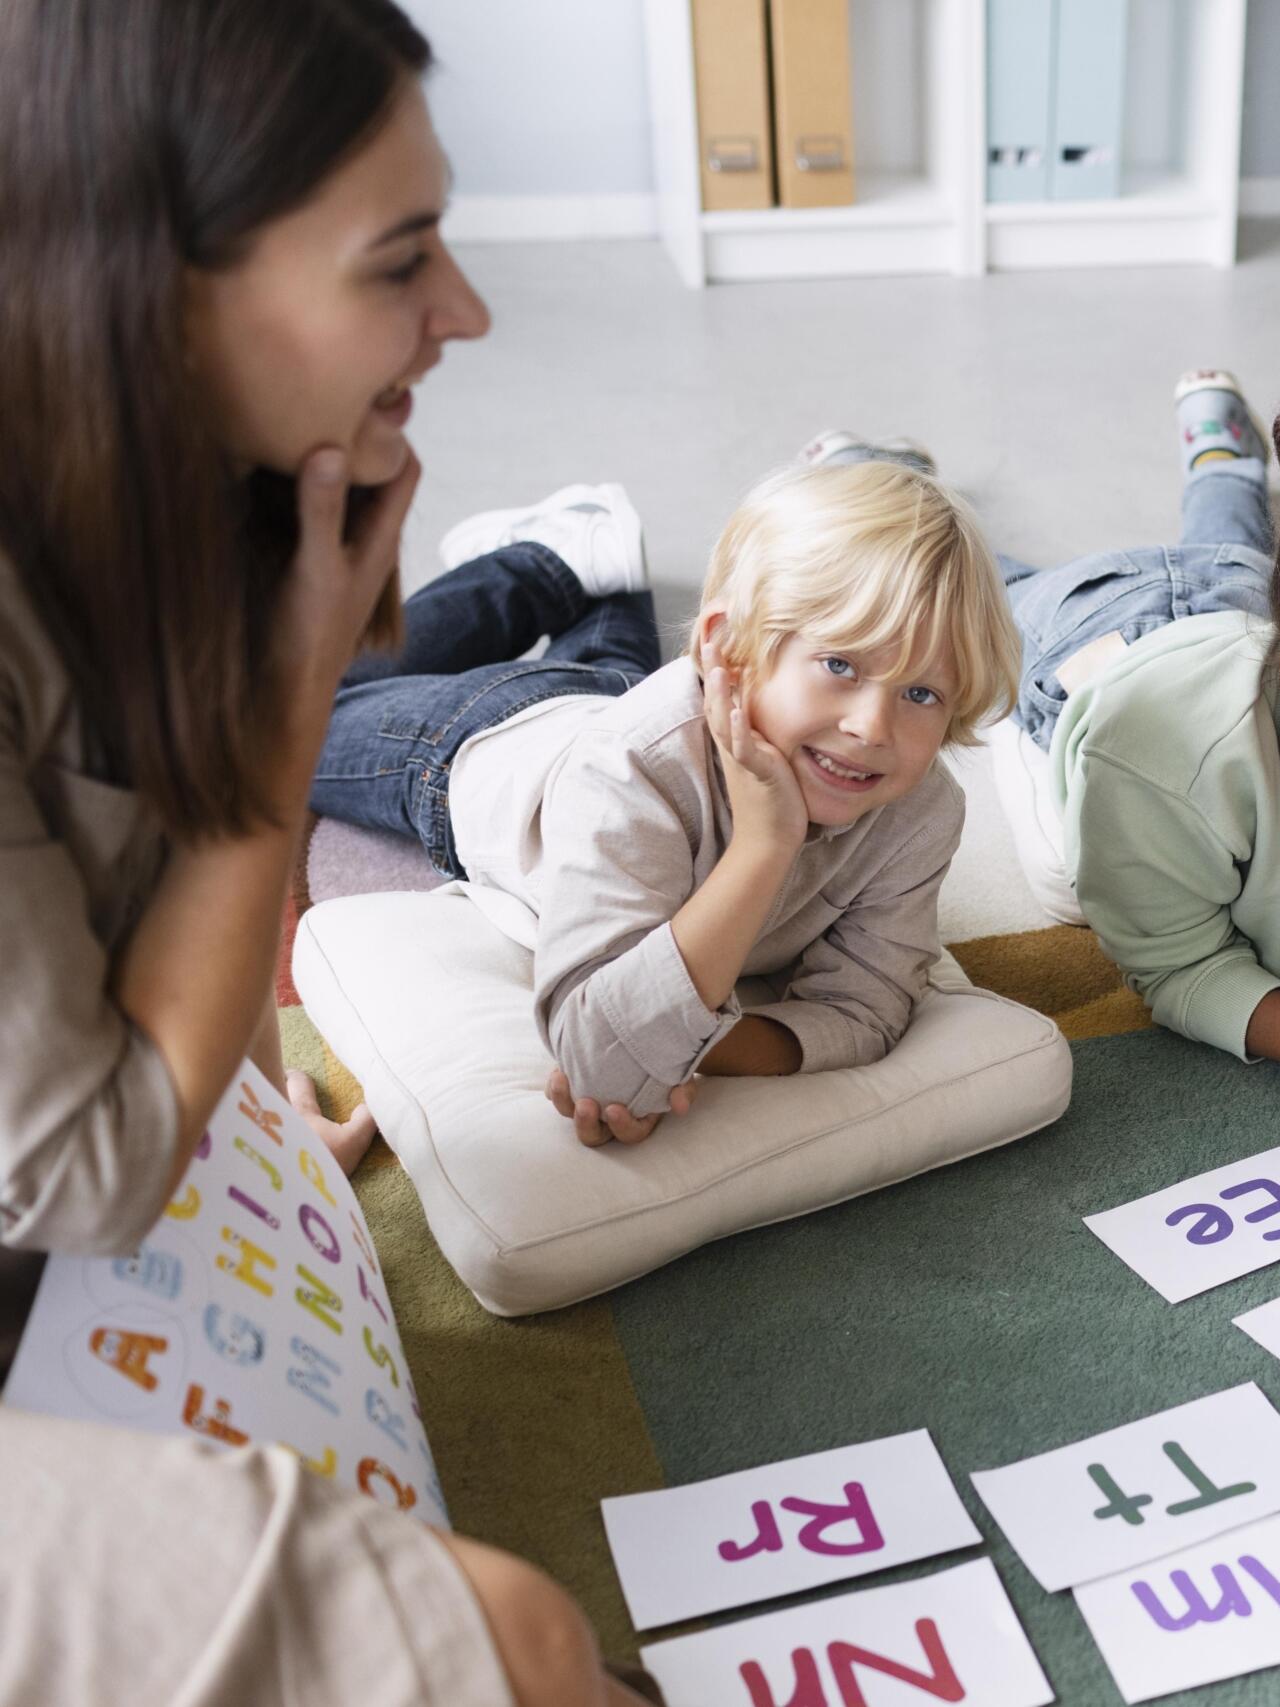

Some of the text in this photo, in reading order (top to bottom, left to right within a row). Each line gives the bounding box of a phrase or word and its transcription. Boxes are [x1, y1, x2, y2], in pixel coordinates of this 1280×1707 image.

[238, 1082, 283, 1147] K
[216, 1226, 277, 1298] H
[299, 1203, 342, 1264] O
[295, 1263, 343, 1336] N
[90, 1327, 168, 1392] A
[181, 1382, 250, 1447] F
[1087, 1441, 1258, 1526] Tt
[717, 1481, 885, 1563] Rr
